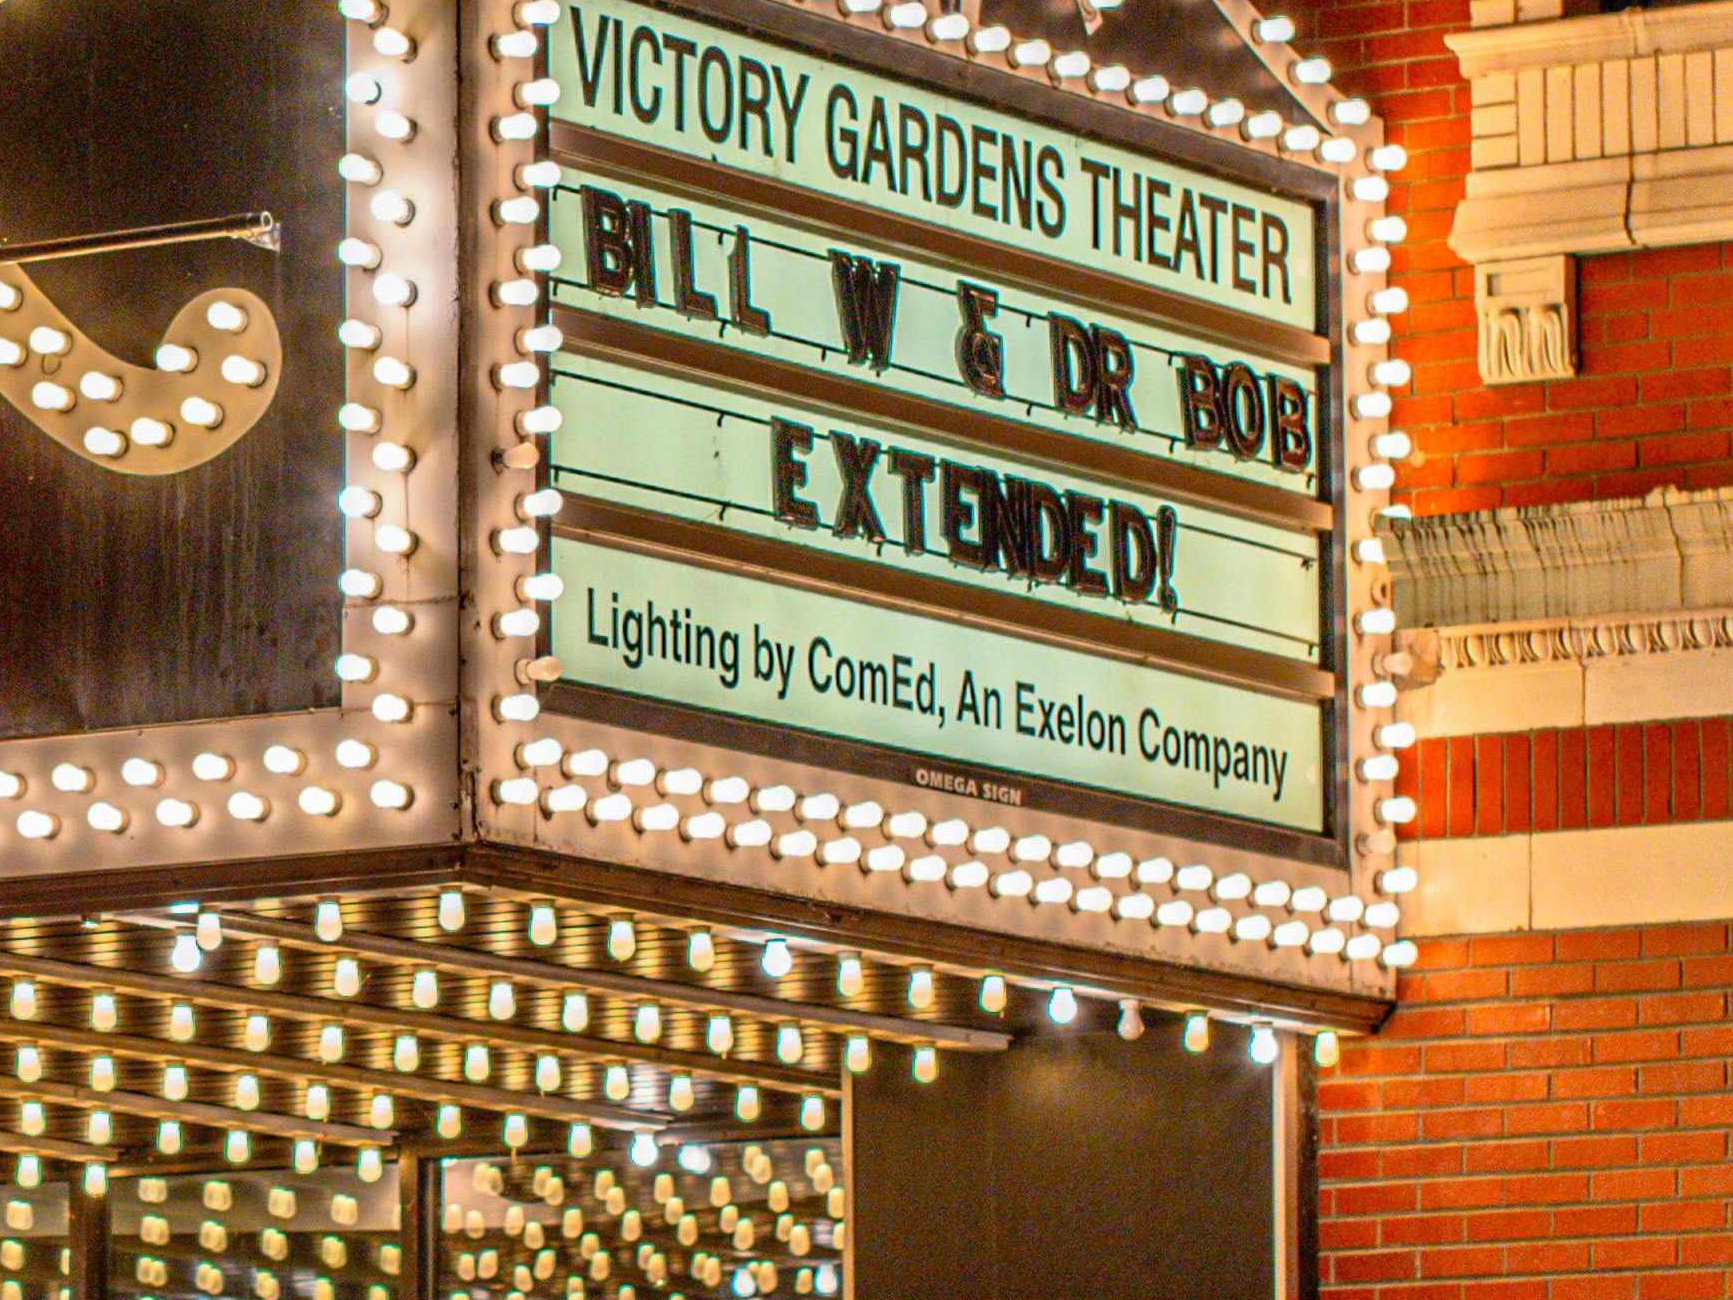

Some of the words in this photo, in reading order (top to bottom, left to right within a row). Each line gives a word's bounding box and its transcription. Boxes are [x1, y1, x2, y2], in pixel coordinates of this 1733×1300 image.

[569, 4, 811, 164] VICTORY
[826, 84, 1066, 238] GARDENS
[1080, 156, 1293, 305] THEATER
[579, 183, 771, 337] BILL
[828, 248, 902, 372] W
[956, 279, 1007, 399] &
[1048, 311, 1137, 433] DR
[1176, 350, 1313, 474] BOB
[770, 414, 1180, 614] EXTENDED!
[585, 586, 741, 687] Lighting
[752, 622, 794, 700] by
[806, 634, 948, 730] ComEd,
[956, 668, 1004, 733] An
[1015, 681, 1128, 757] Exelon
[1137, 707, 1289, 801] Company
[915, 768, 979, 797] OMEGA
[982, 781, 1022, 806] SIGN
